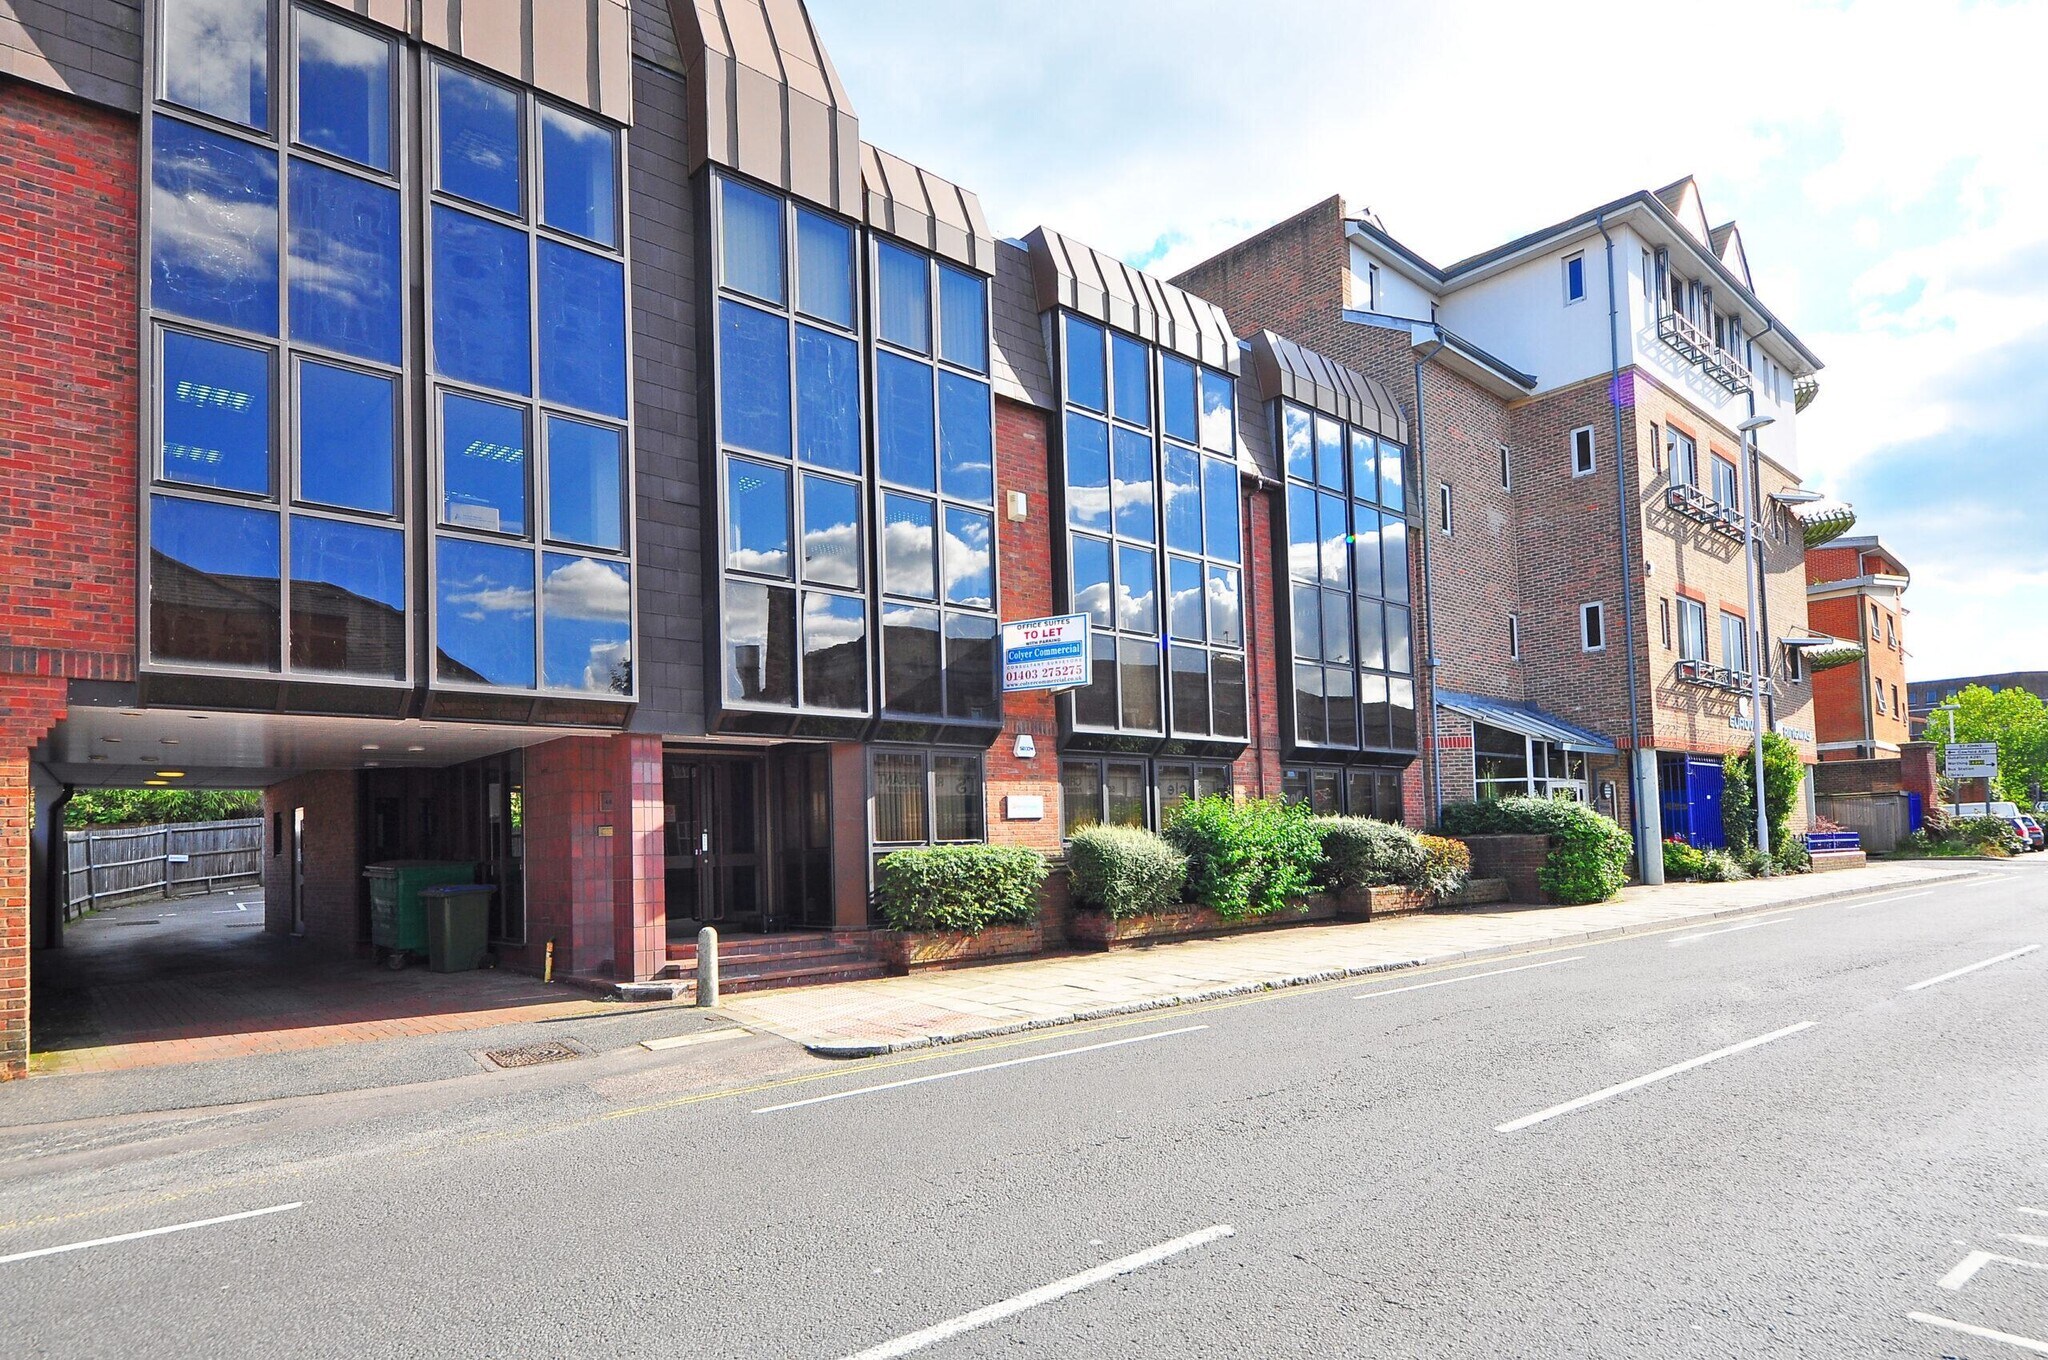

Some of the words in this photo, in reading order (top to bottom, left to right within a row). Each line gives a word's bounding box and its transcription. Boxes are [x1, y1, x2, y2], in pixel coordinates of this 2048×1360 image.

[1016, 622, 1041, 630] OFFICE
[1044, 619, 1070, 627] SUITES
[1024, 630, 1038, 640] TO
[1042, 627, 1063, 638] LET
[1008, 651, 1033, 660] Colyer
[1034, 643, 1080, 657] Commercial
[1006, 670, 1038, 681] 01403
[1042, 665, 1082, 678] 275275
